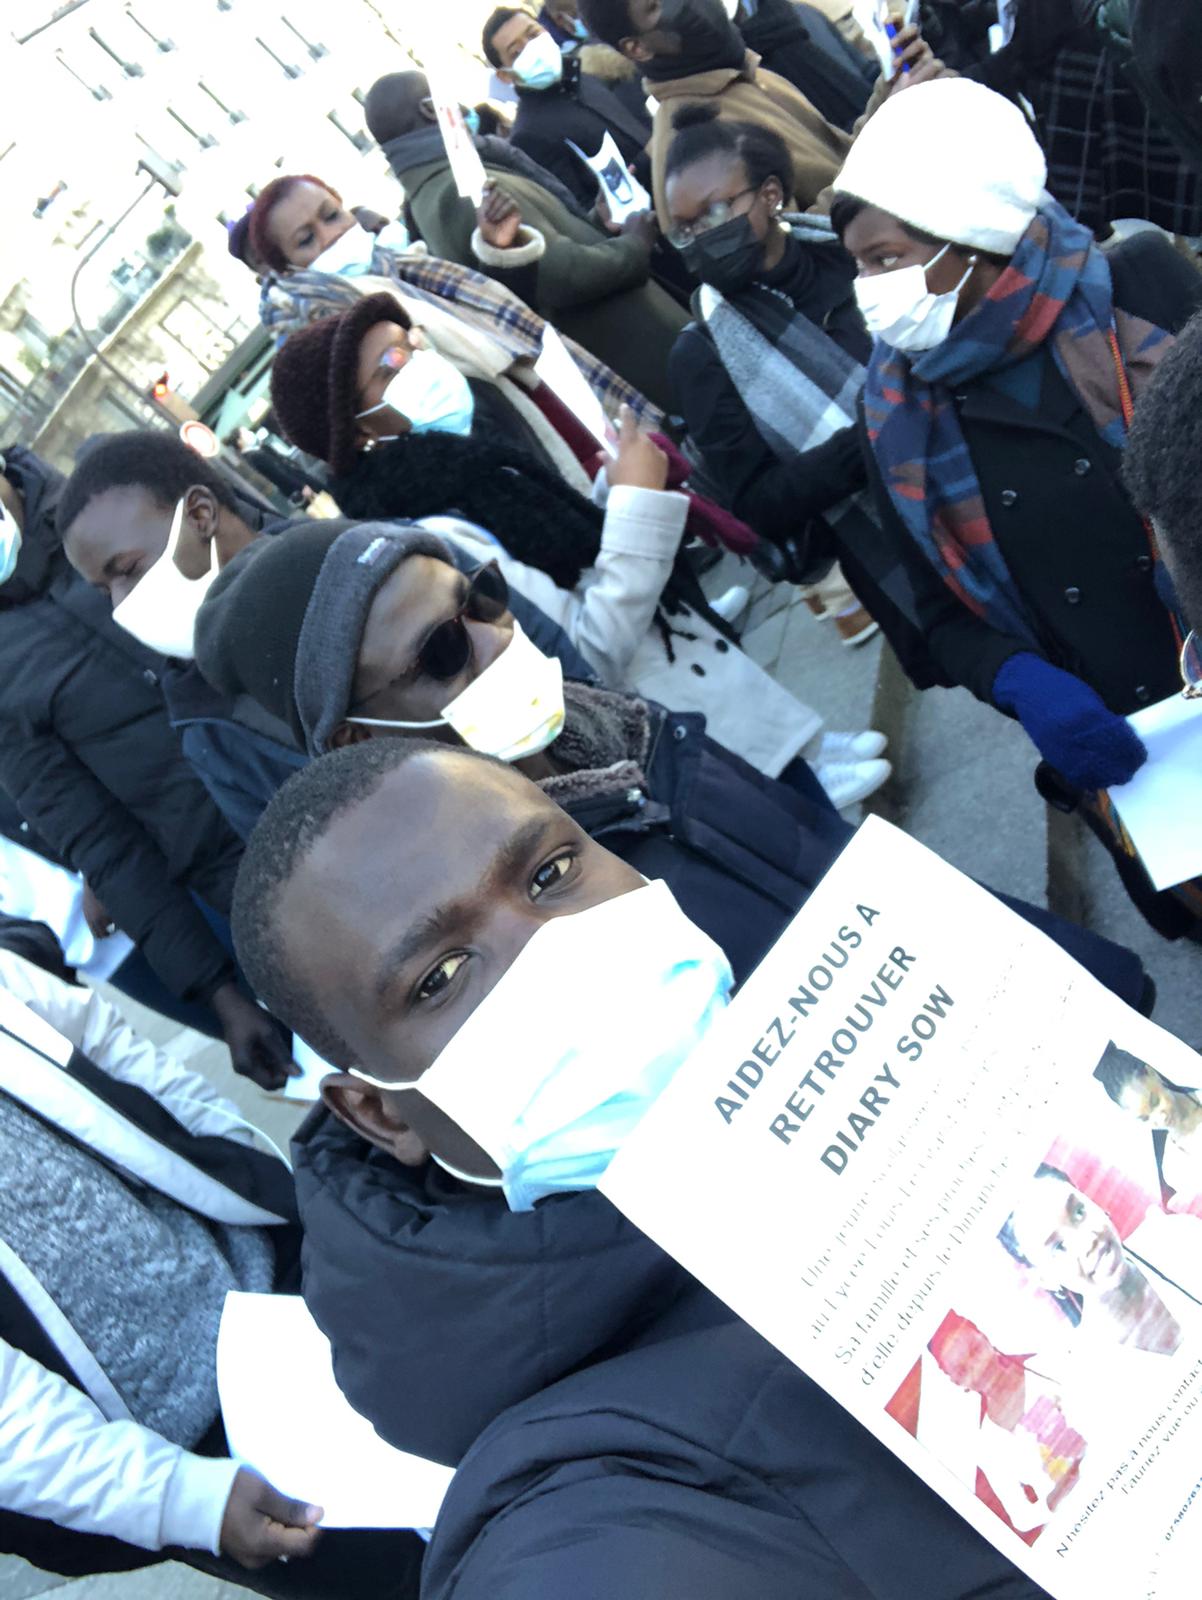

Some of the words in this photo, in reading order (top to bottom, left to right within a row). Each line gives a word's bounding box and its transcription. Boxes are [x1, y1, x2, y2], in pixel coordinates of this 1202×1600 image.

[713, 924, 863, 1125] AIDEZ-NOUS
[768, 945, 917, 1146] RETROUVER
[819, 1061, 901, 1177] DIARY
[896, 983, 955, 1062] SOW
[834, 1336, 864, 1365] Sa
[1106, 1461, 1129, 1491] pas
[1138, 1413, 1167, 1448] nous
